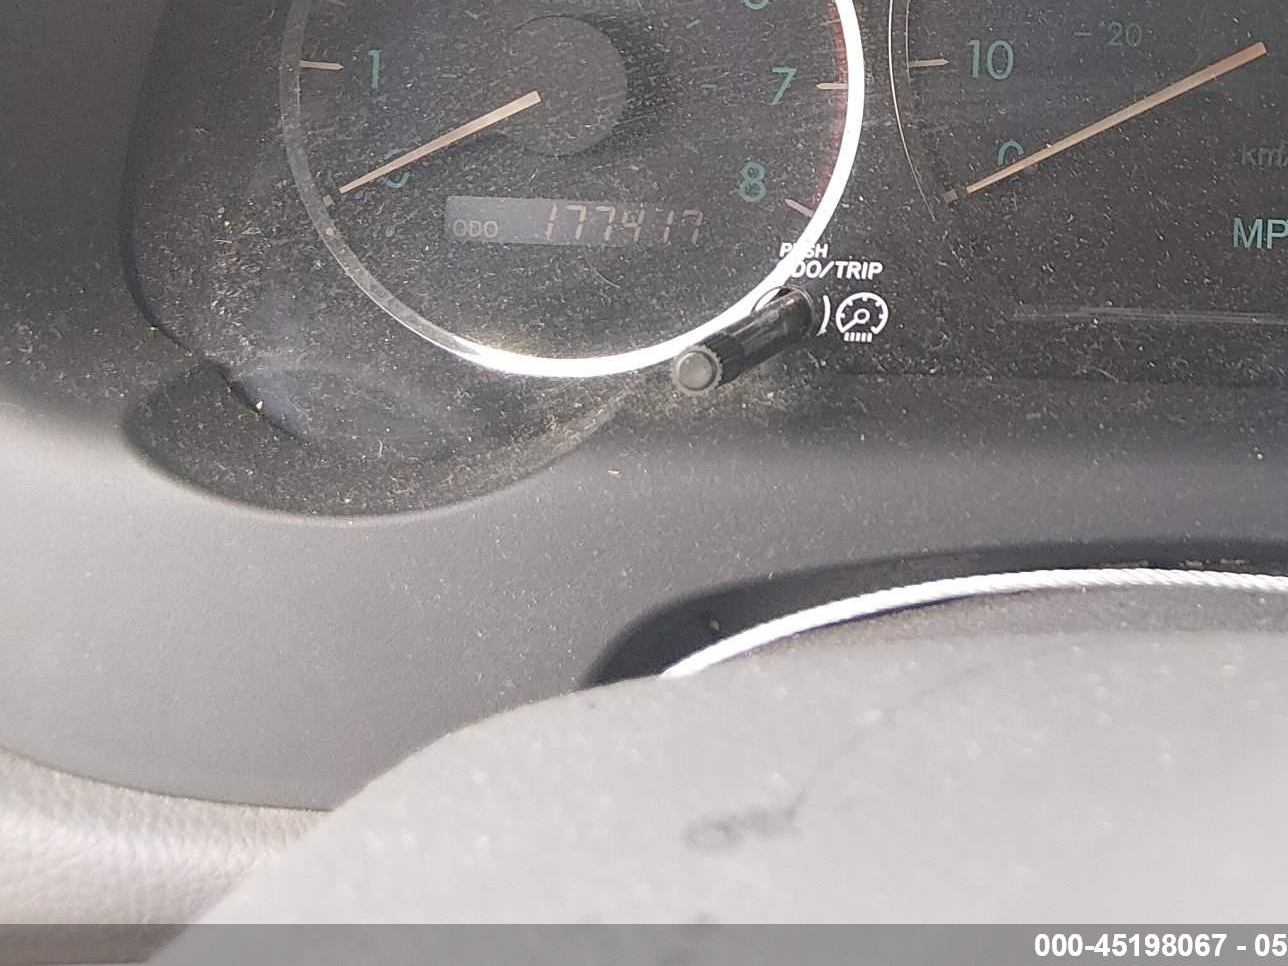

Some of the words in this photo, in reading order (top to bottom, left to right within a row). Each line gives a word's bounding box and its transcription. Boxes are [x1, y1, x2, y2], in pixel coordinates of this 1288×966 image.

[1107, 22, 1143, 47] 20
[368, 50, 380, 88] 1
[967, 39, 1014, 80] 10
[771, 66, 798, 106] 7
[738, 161, 767, 202] 8
[452, 220, 499, 239] ODO
[545, 203, 704, 244] 177417
